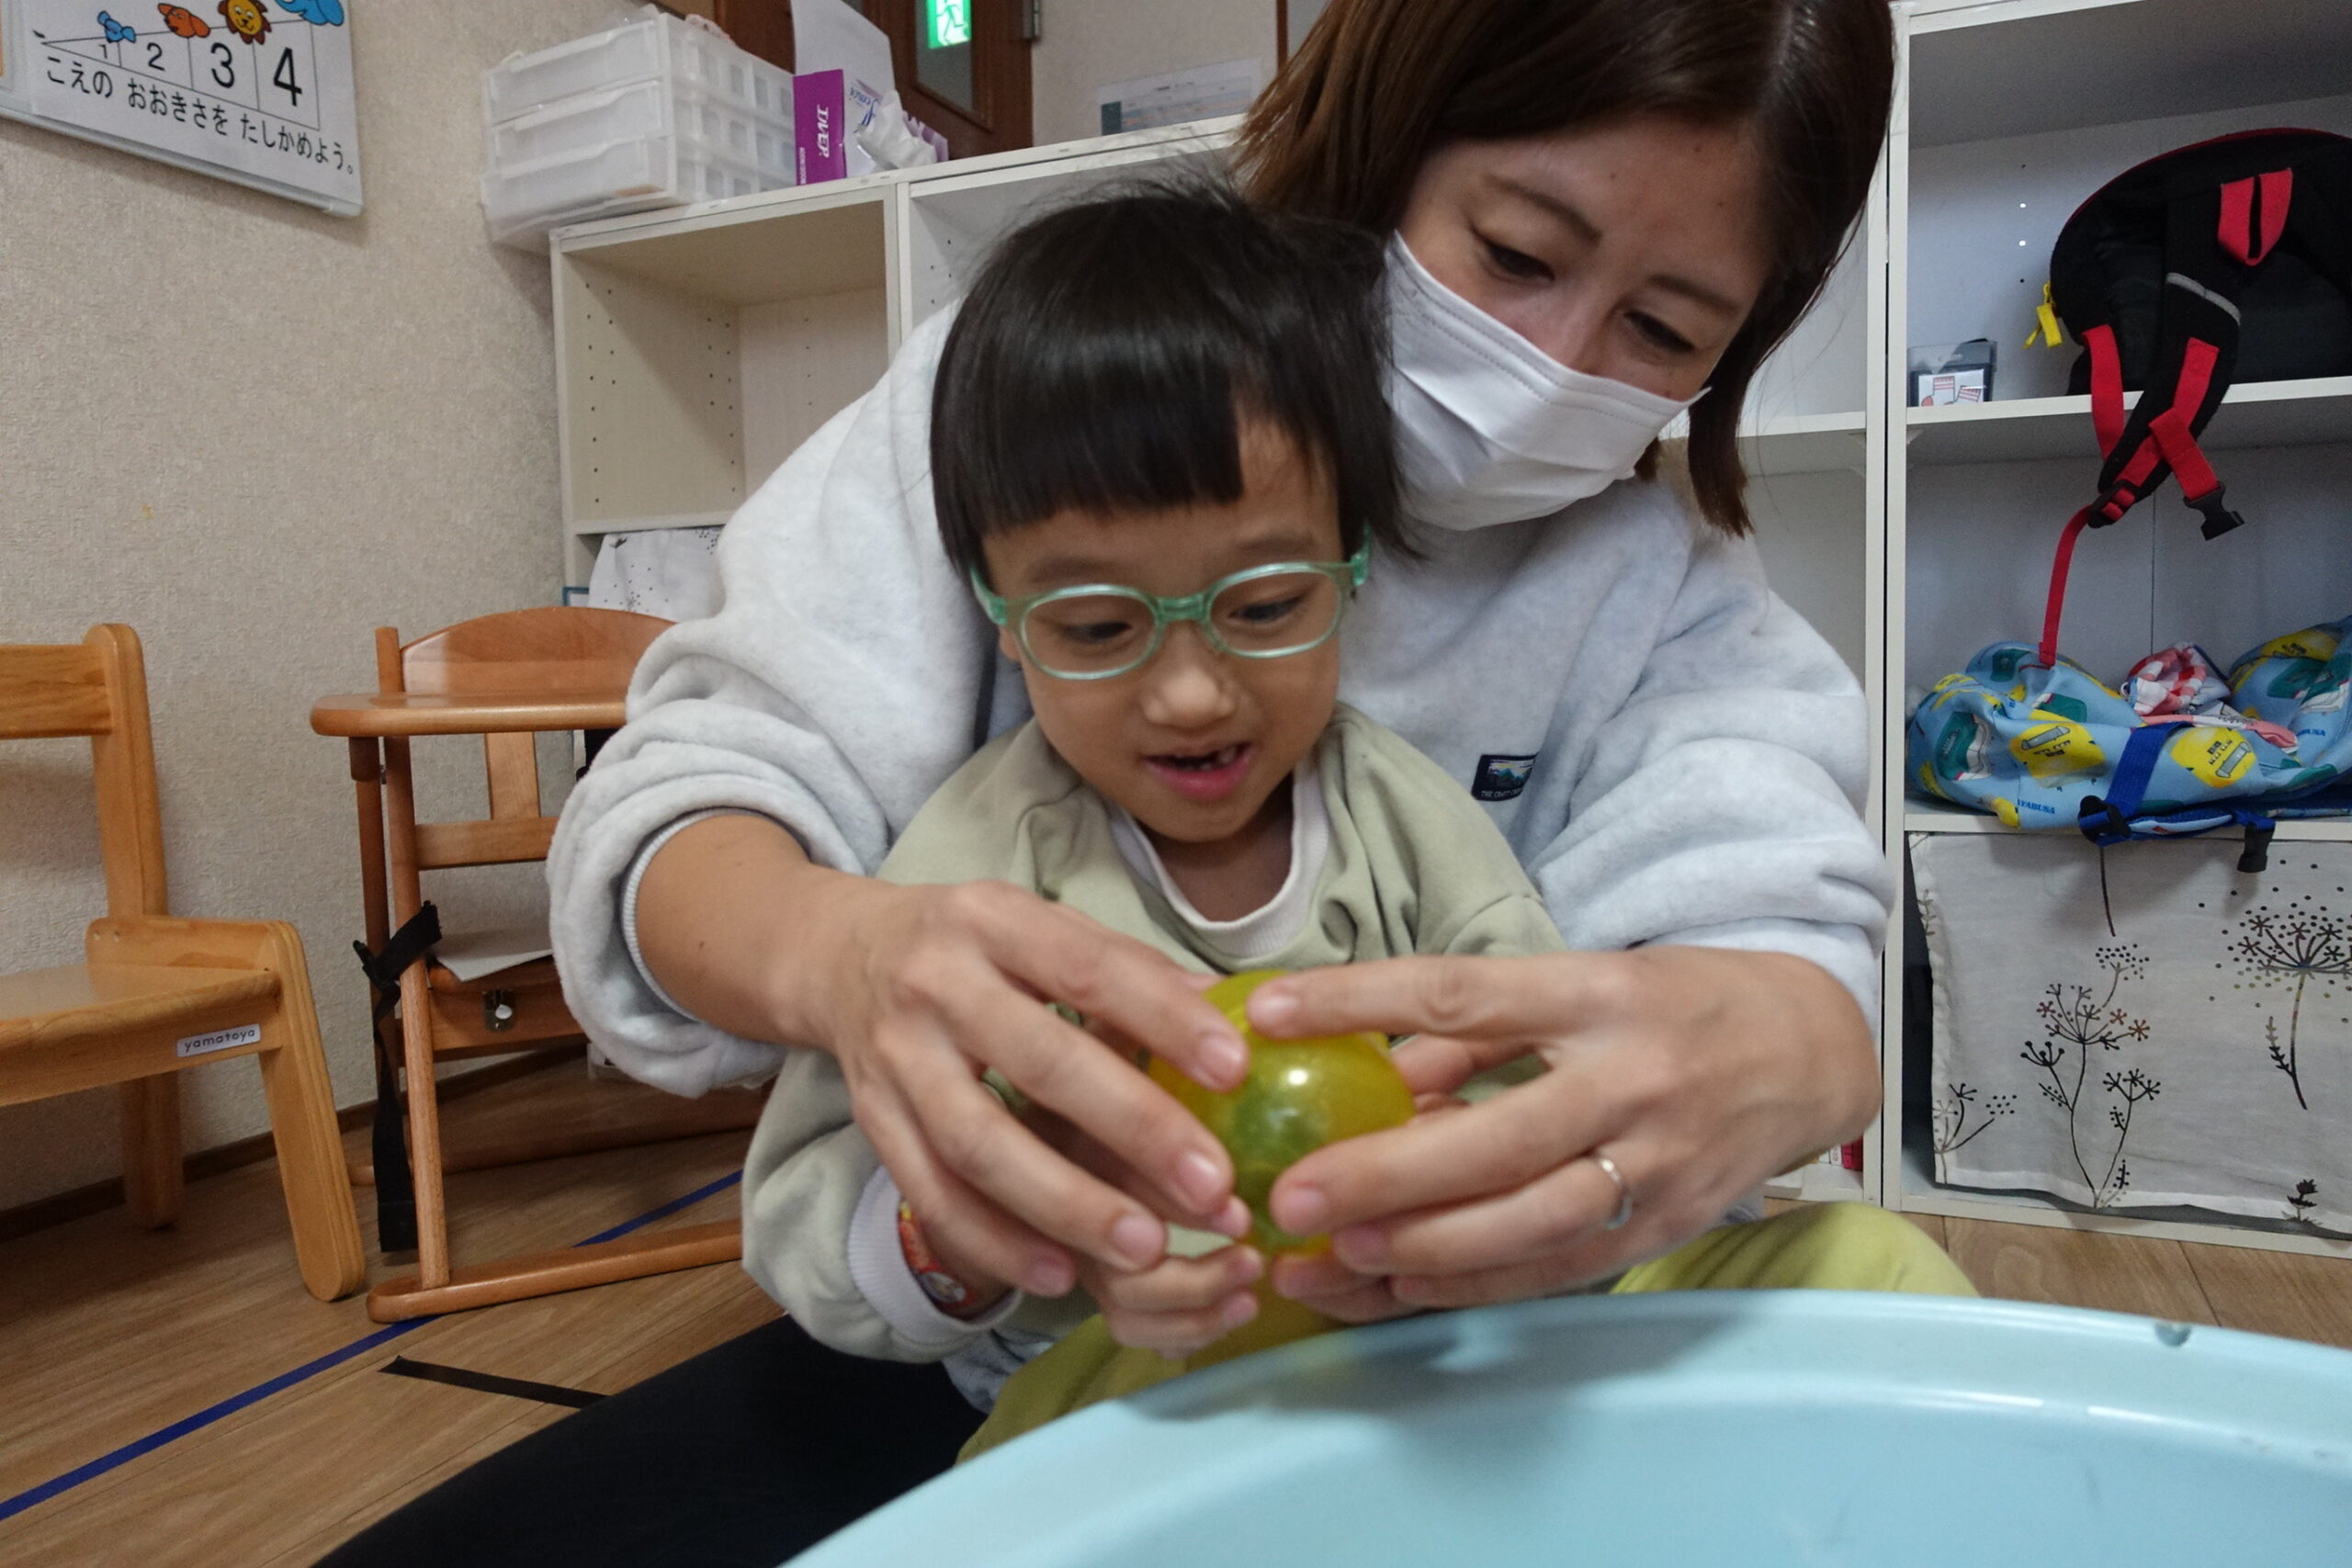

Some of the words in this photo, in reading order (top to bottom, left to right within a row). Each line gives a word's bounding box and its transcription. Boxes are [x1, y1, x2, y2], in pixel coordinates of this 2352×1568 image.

[98, 43, 108, 59] 1
[146, 42, 165, 72] 2
[209, 42, 235, 89] 3
[273, 47, 302, 107] 4
[47, 55, 113, 98] こえの
[127, 77, 229, 137] おおきさを
[240, 113, 355, 175] たしかめよう。
[184, 1028, 255, 1053] yamatoya
